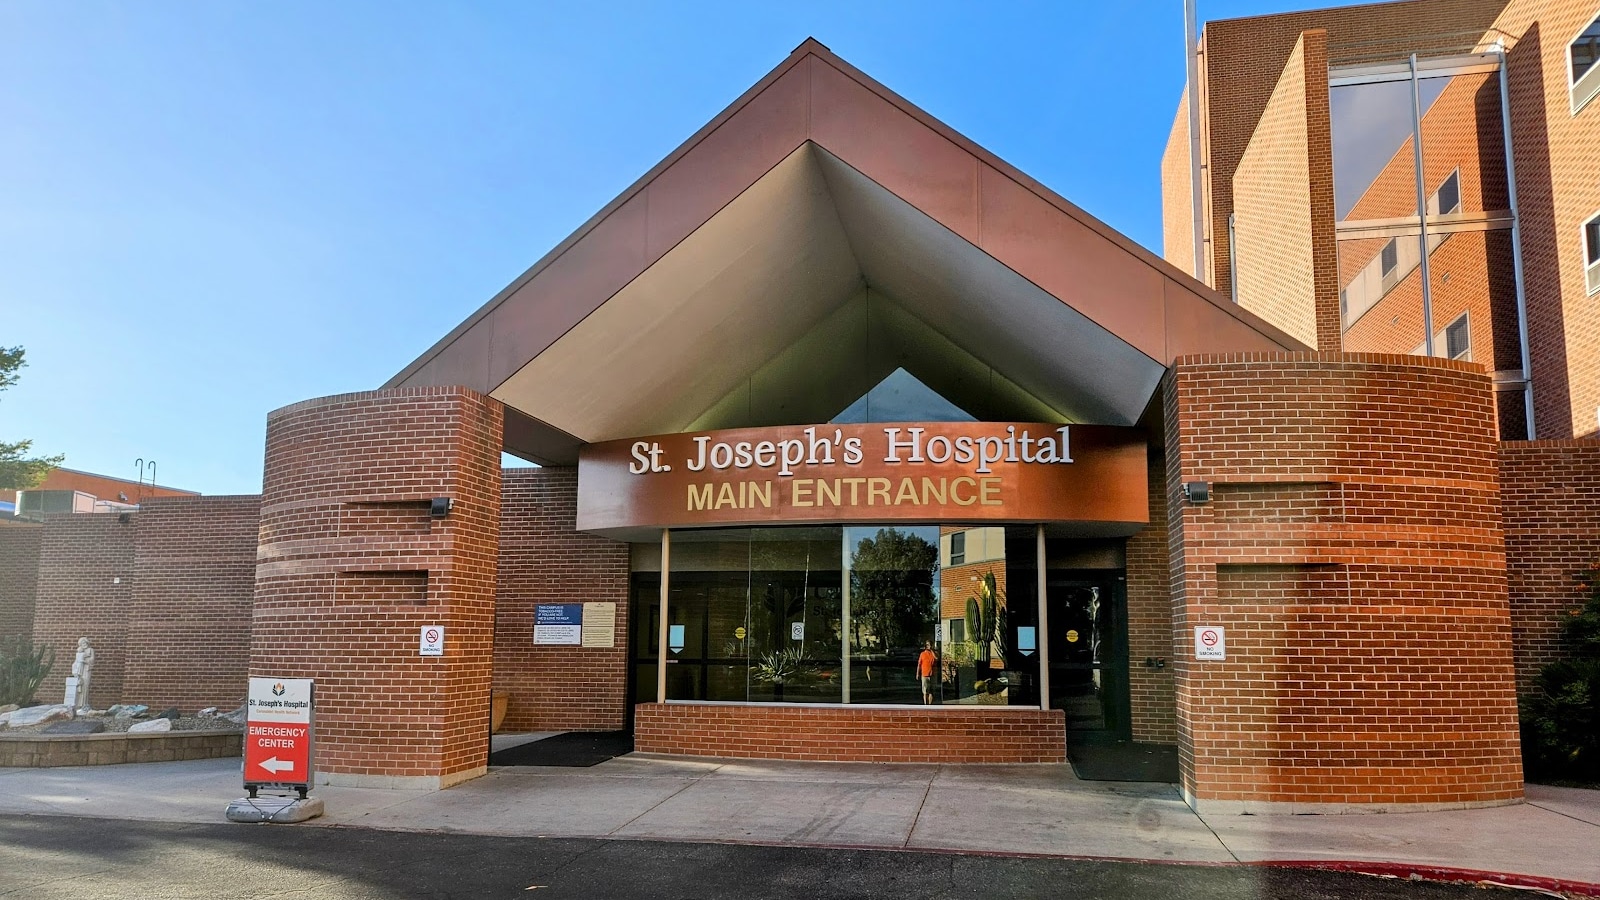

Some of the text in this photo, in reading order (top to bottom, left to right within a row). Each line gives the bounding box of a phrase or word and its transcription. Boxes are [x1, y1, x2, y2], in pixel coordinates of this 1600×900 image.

[629, 425, 1074, 476] St. Joseph's Hospital
[687, 476, 1003, 511] MAIN ENTRANCE
[258, 700, 282, 708] Joseph's
[284, 700, 308, 709] Hospital
[249, 726, 306, 736] EMERGENCY
[258, 738, 294, 748] CENTER
